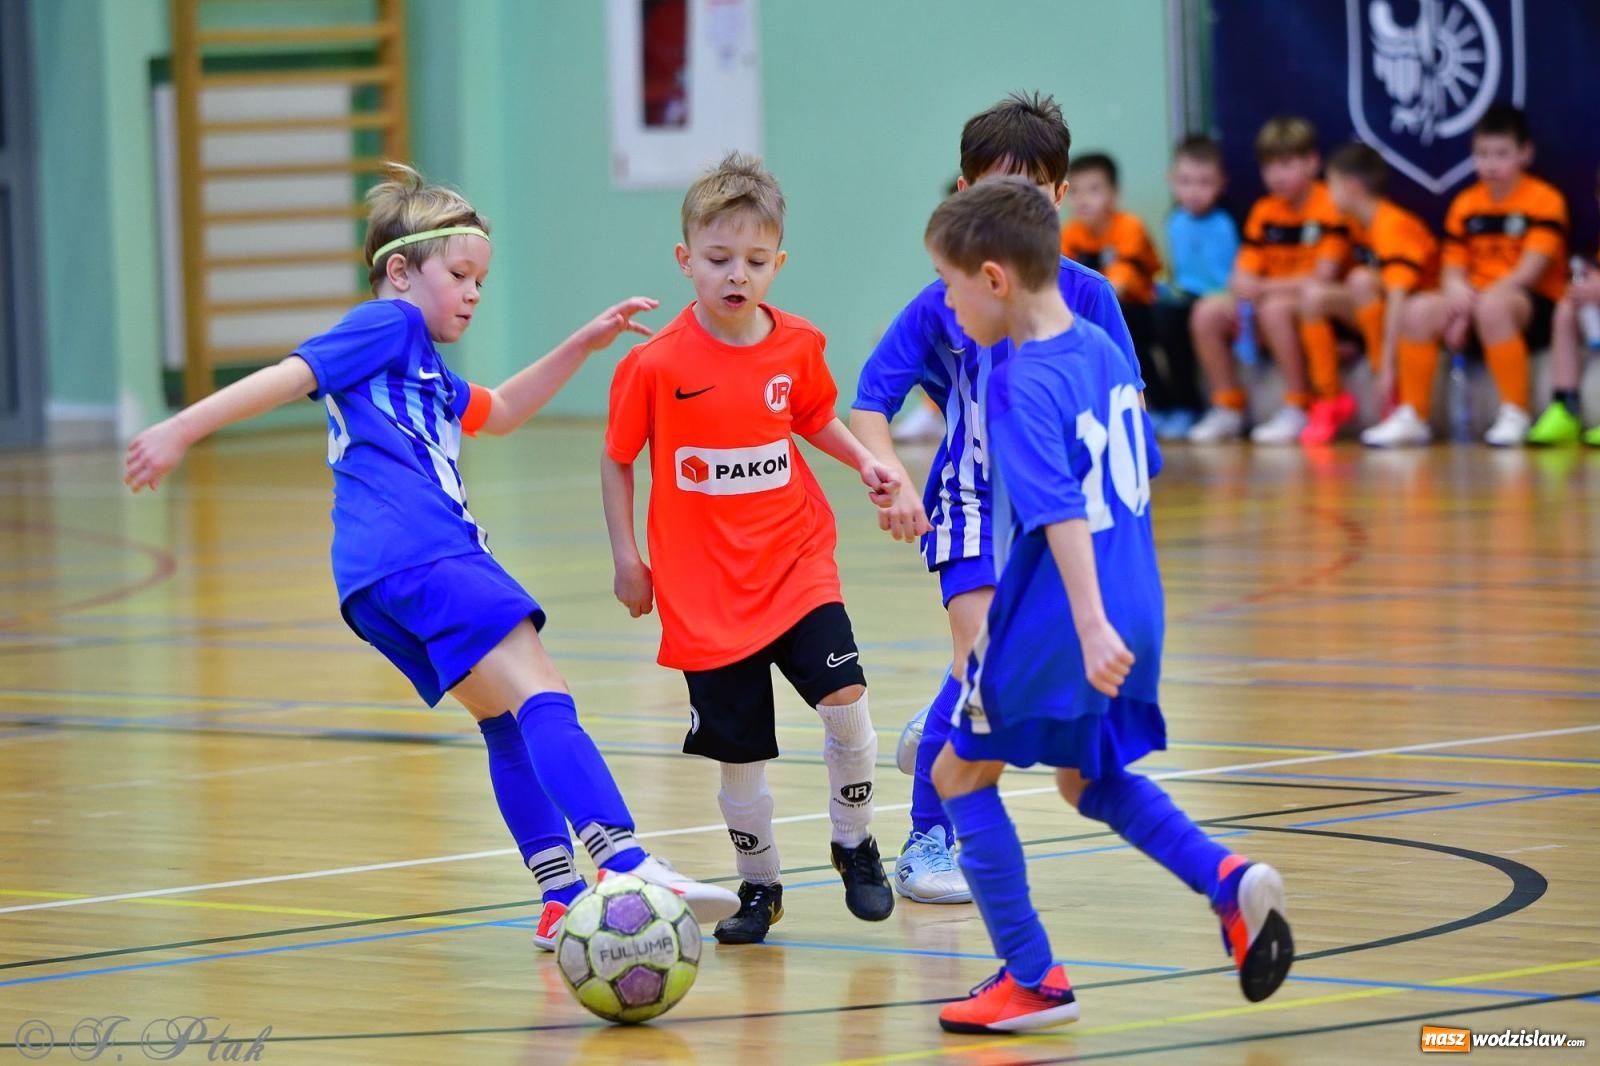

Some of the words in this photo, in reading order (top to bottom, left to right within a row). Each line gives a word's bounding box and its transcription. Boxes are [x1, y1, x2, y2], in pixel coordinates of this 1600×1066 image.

[715, 453, 789, 480] PAKON
[1076, 384, 1151, 534] 10
[847, 785, 868, 799] JR
[731, 832, 752, 847] JR
[600, 936, 674, 963] FULUMA
